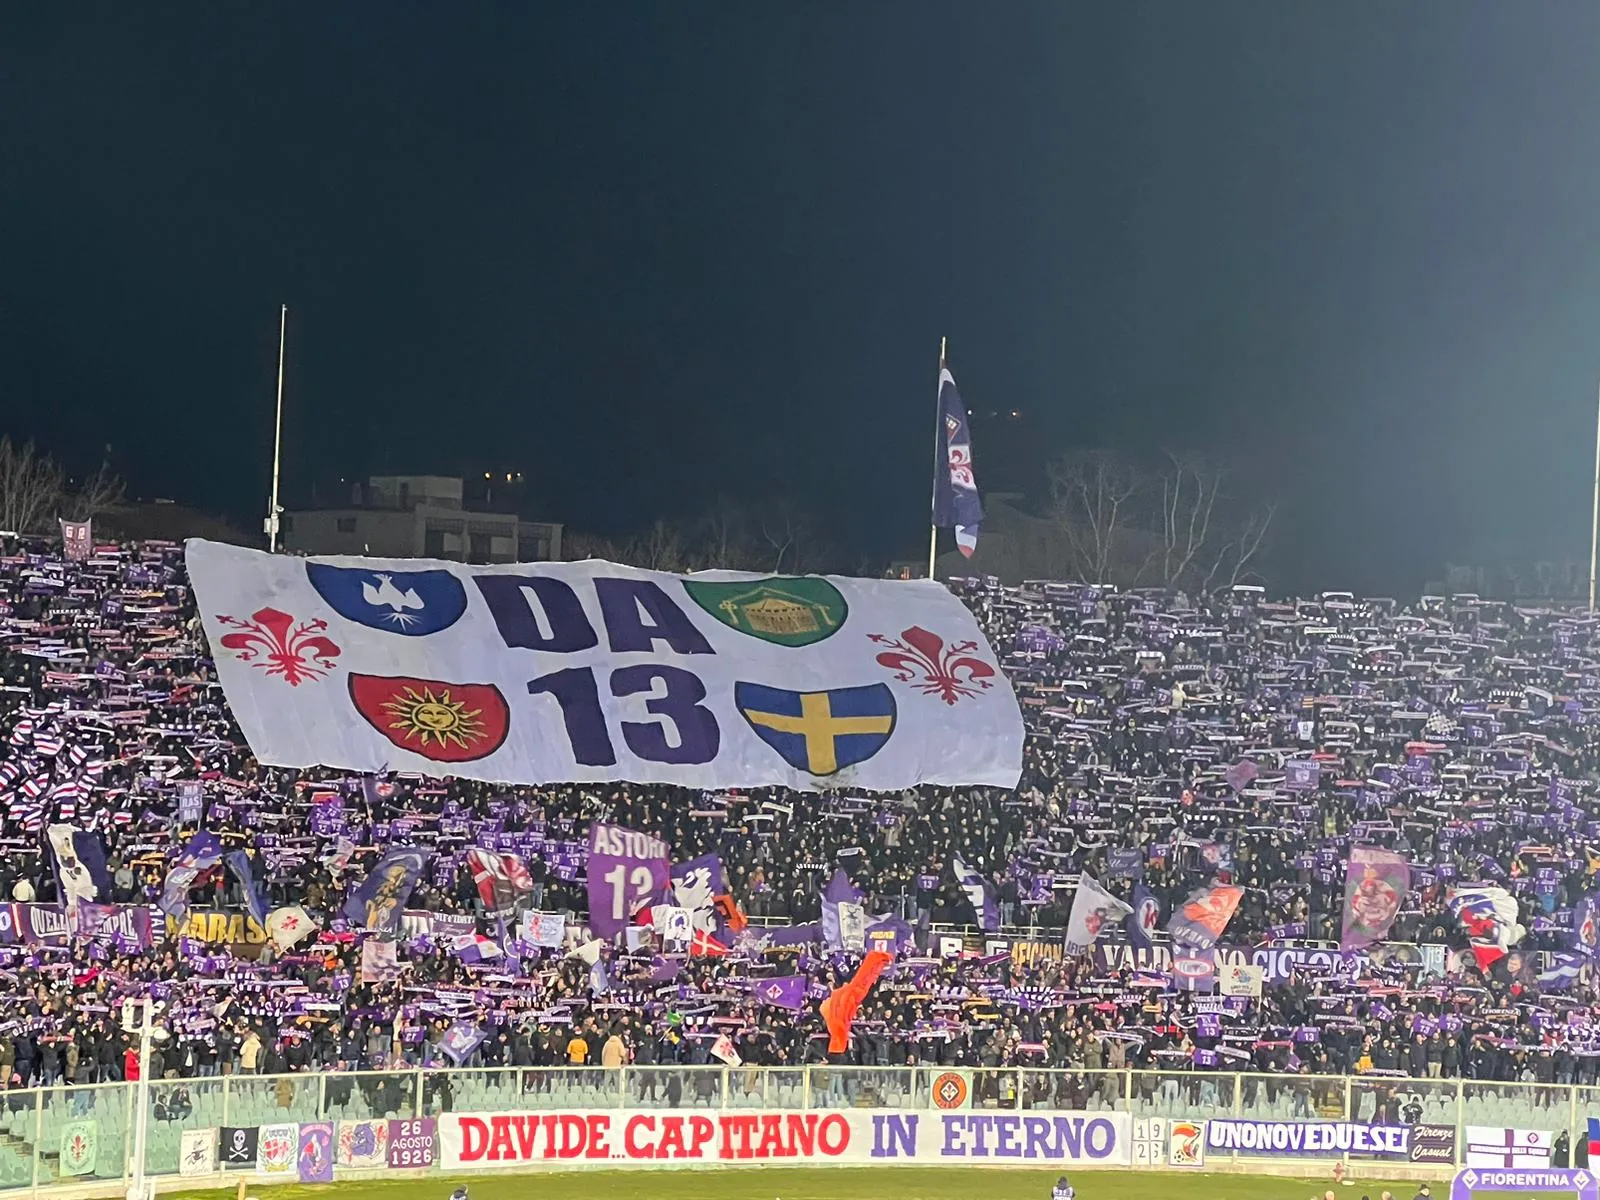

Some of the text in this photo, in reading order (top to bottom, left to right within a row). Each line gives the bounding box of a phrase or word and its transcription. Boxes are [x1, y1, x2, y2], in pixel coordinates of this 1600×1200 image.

[472, 574, 717, 655] DA
[527, 664, 720, 766] 13
[401, 1121, 421, 1135] 26
[1413, 1126, 1453, 1140] Firenze
[391, 1135, 433, 1149] AGOSTO
[624, 1113, 851, 1159] CAPITANO
[871, 1114, 919, 1158] IN
[941, 1114, 1116, 1159] ETERNO
[1209, 1120, 1409, 1153] UNONOVEDUESEI
[391, 1150, 432, 1165] 1926
[1411, 1145, 1451, 1161] Casual
[1481, 1173, 1569, 1187] FIORENTINA
